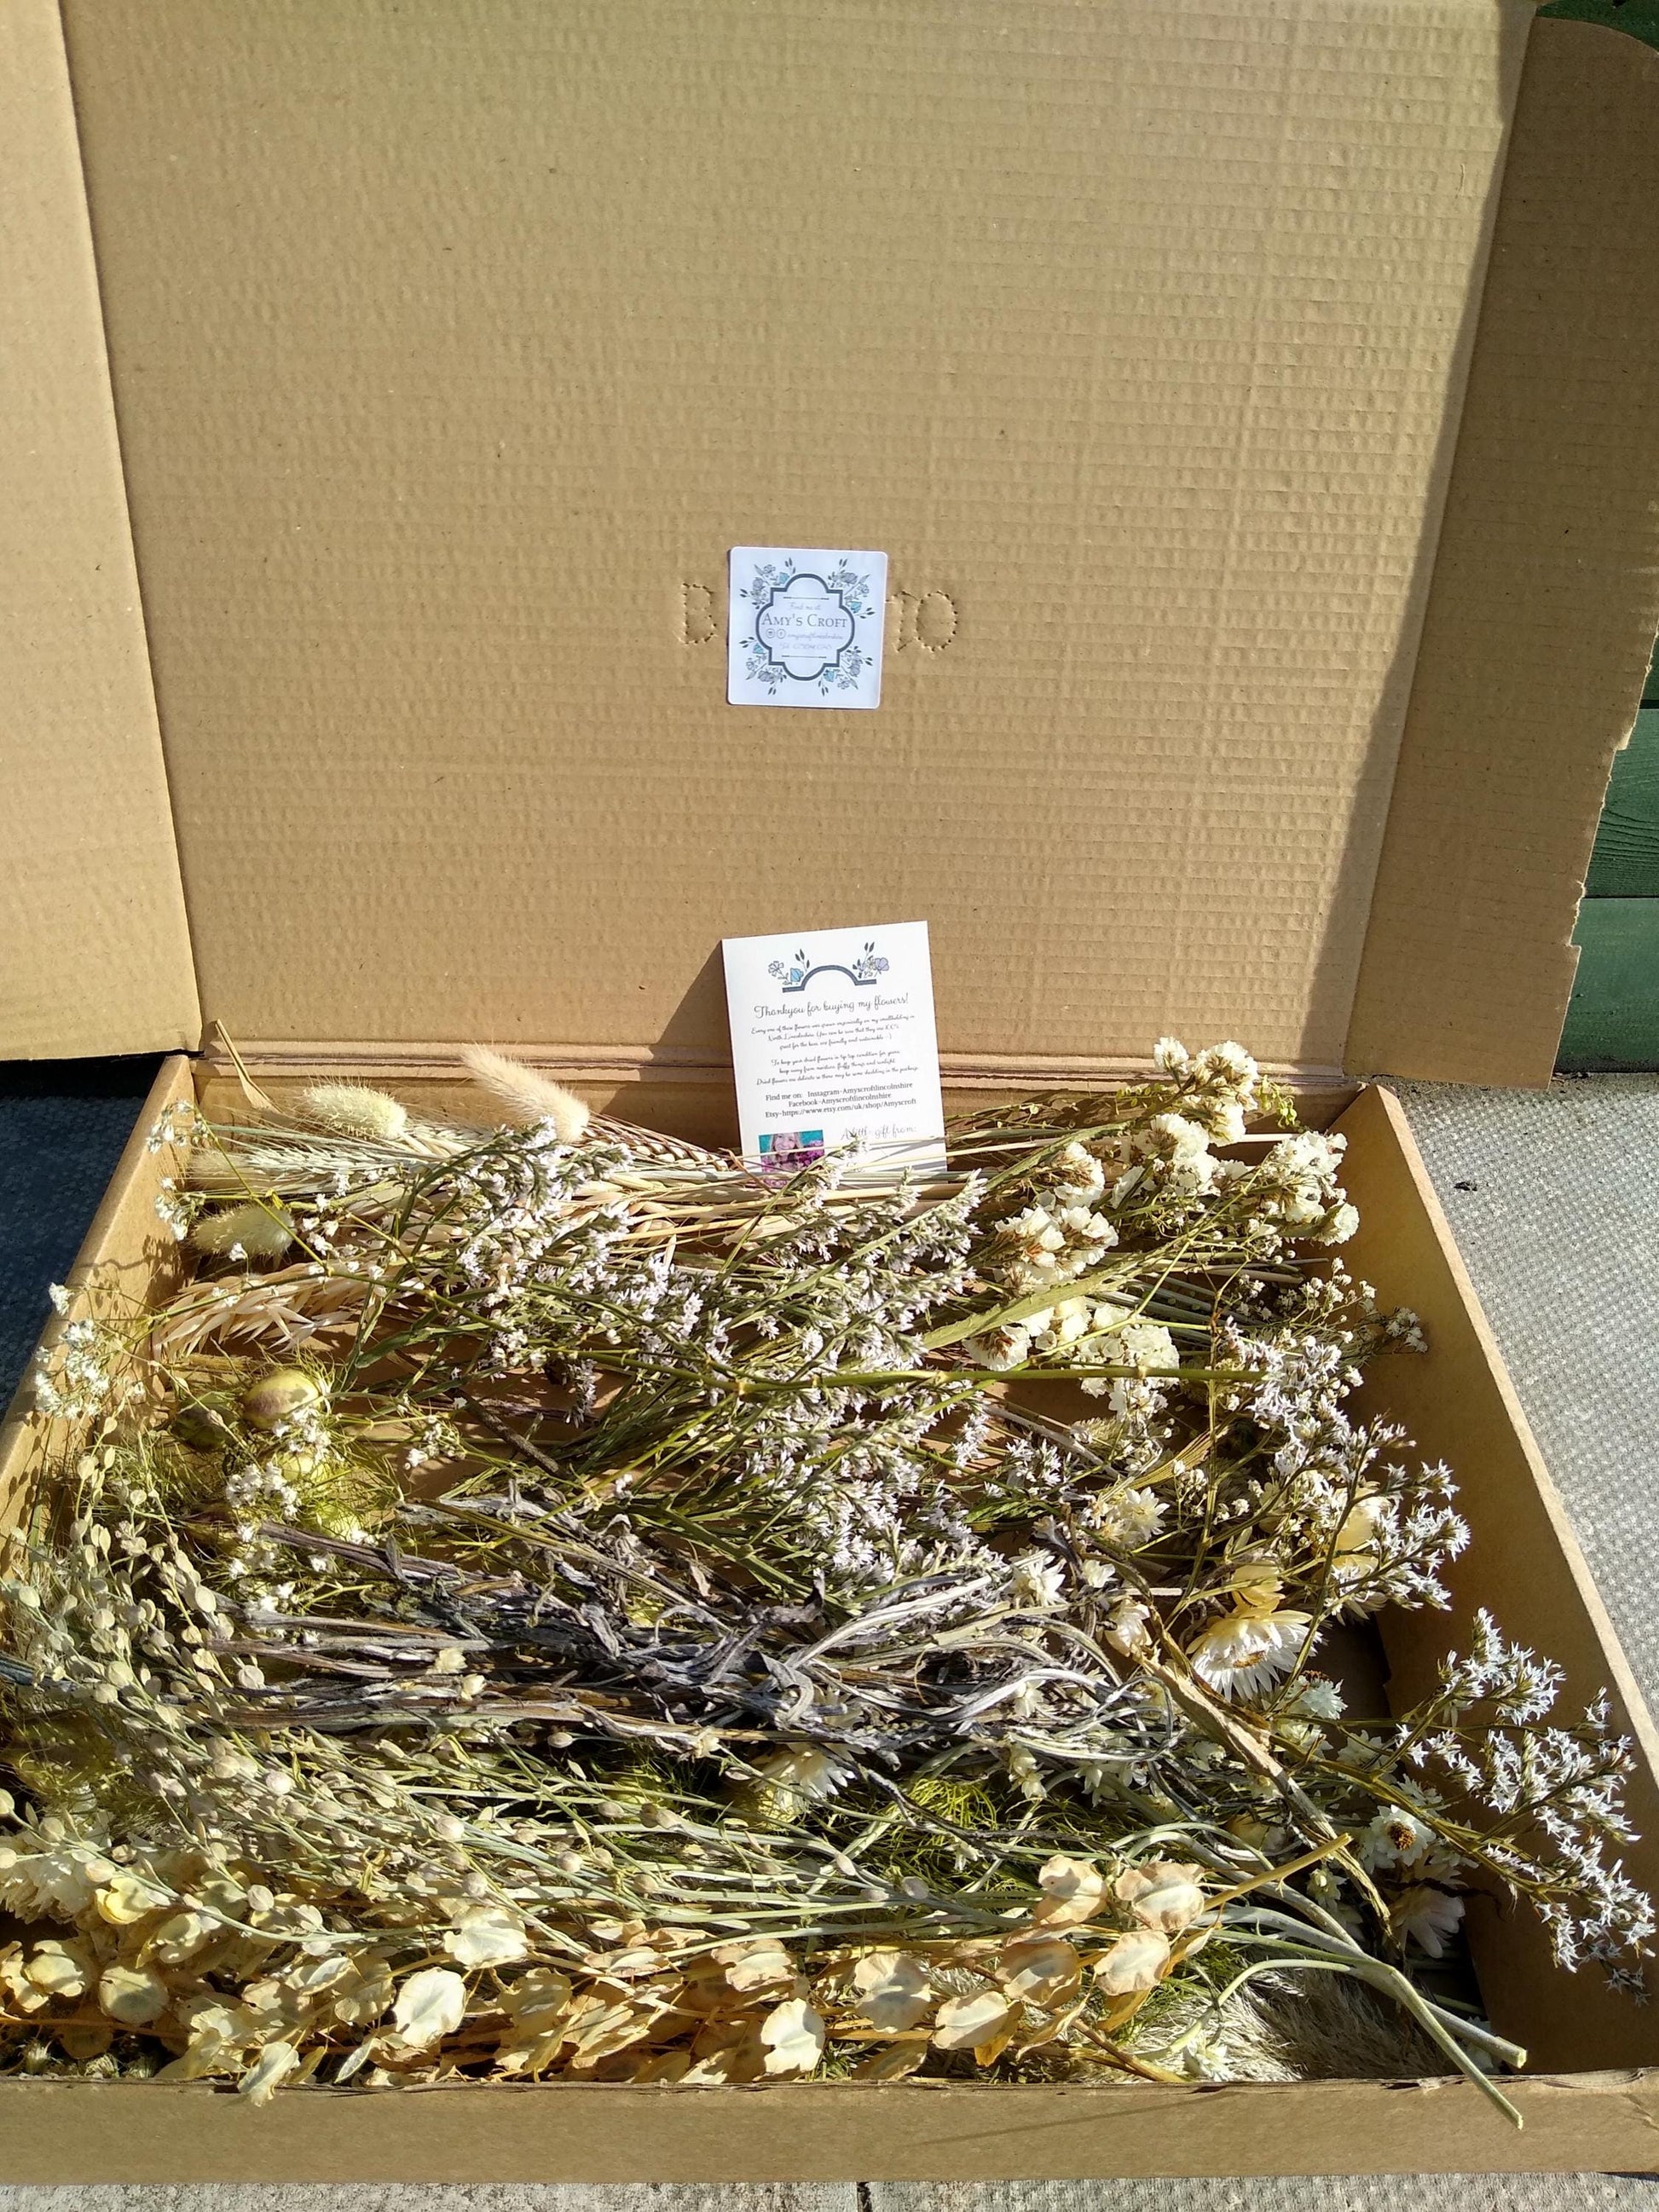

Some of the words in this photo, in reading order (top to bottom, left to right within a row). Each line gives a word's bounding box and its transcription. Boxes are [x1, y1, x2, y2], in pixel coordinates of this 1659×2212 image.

[761, 612, 803, 627] AMY'S
[806, 613, 847, 628] CROFT
[754, 1003, 804, 1019] Thankyou
[807, 1001, 821, 1016] for
[824, 1000, 854, 1014] buying
[858, 1001, 871, 1011] my
[874, 992, 909, 1011] flowers!
[766, 1093, 780, 1101] Find
